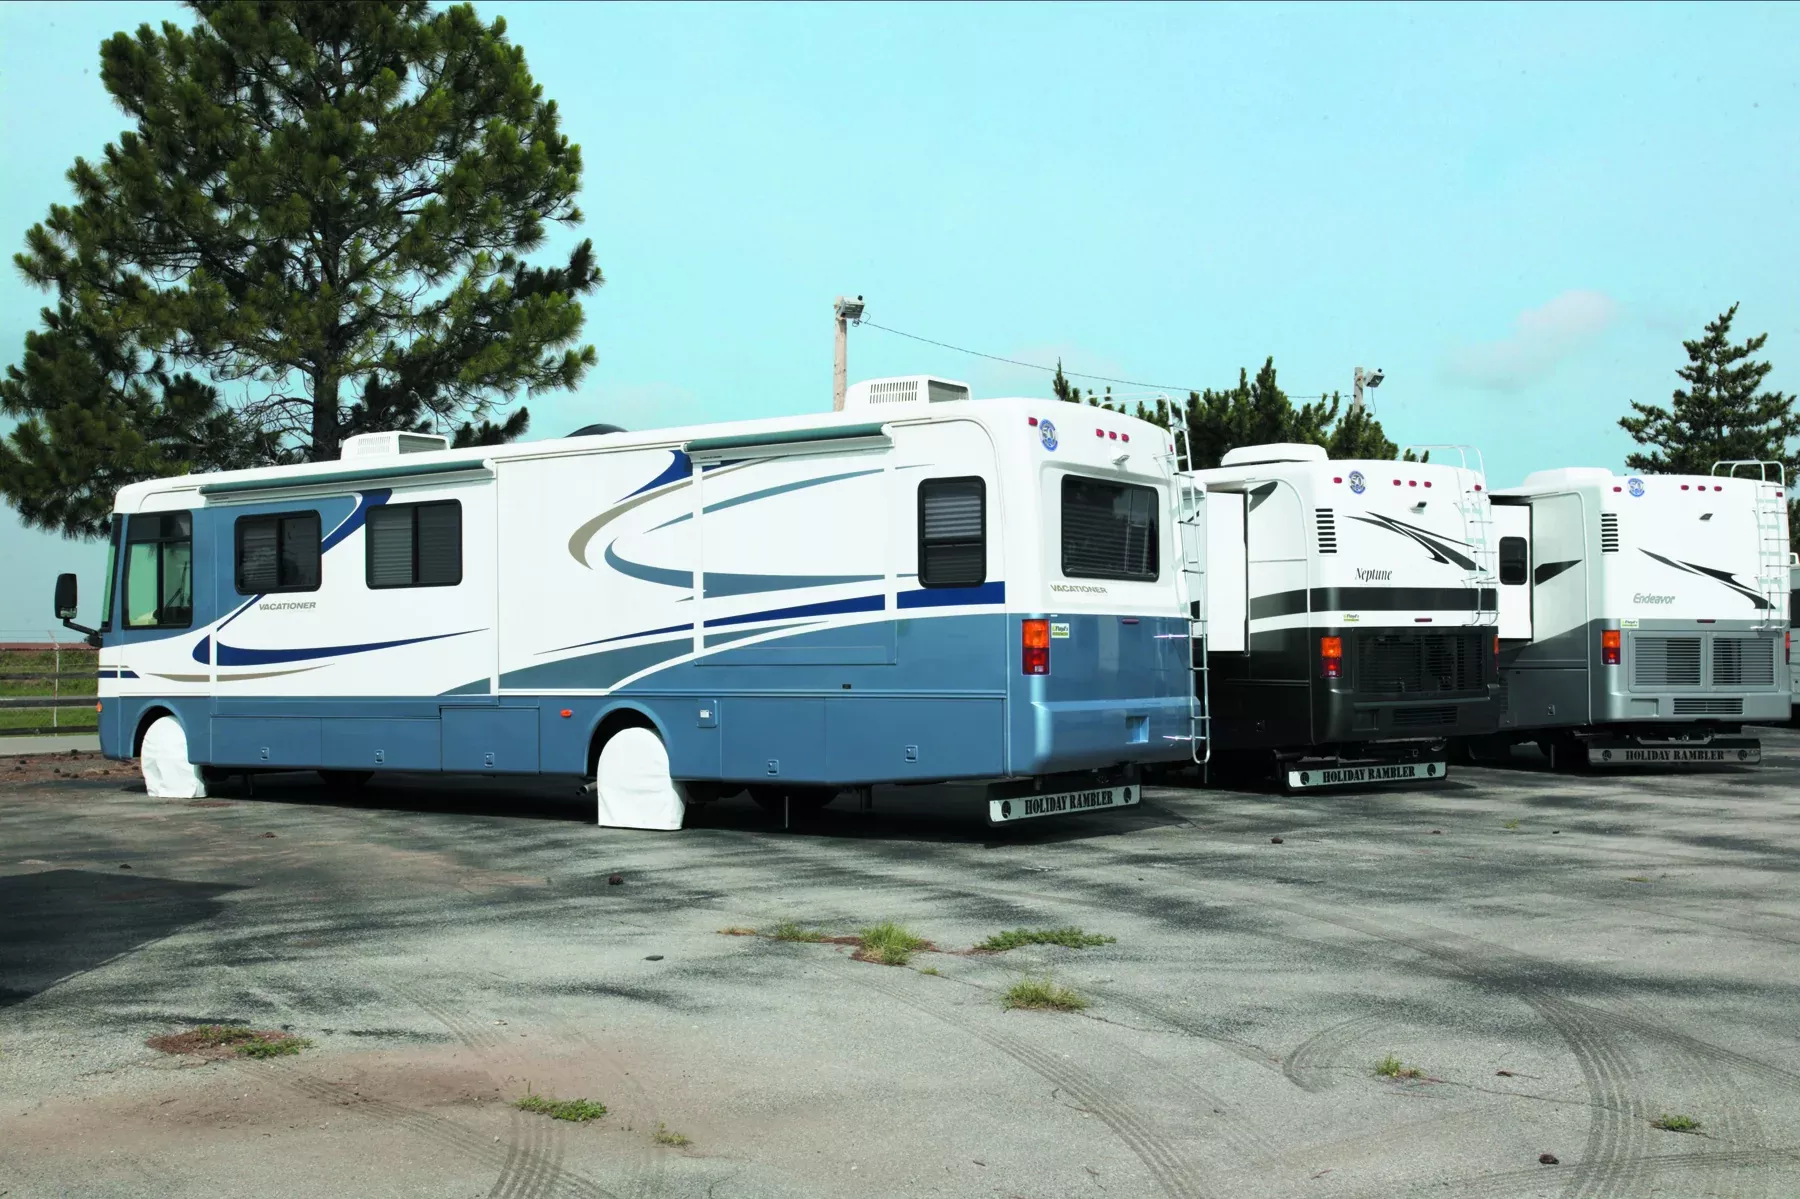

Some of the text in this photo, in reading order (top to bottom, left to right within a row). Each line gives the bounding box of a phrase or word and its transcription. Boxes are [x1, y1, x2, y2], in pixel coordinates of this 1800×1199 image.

[1355, 567, 1392, 583] Neptune
[1050, 584, 1108, 594] VACATIONER
[1633, 592, 1676, 604] Endeavor
[259, 601, 317, 611] VACATIONER
[1626, 750, 1725, 761] HOLIDAY RAMBLER
[1322, 765, 1416, 783] HOLIDAY RAMBLER
[1024, 790, 1114, 815] HOLIDAY RAMBLER
